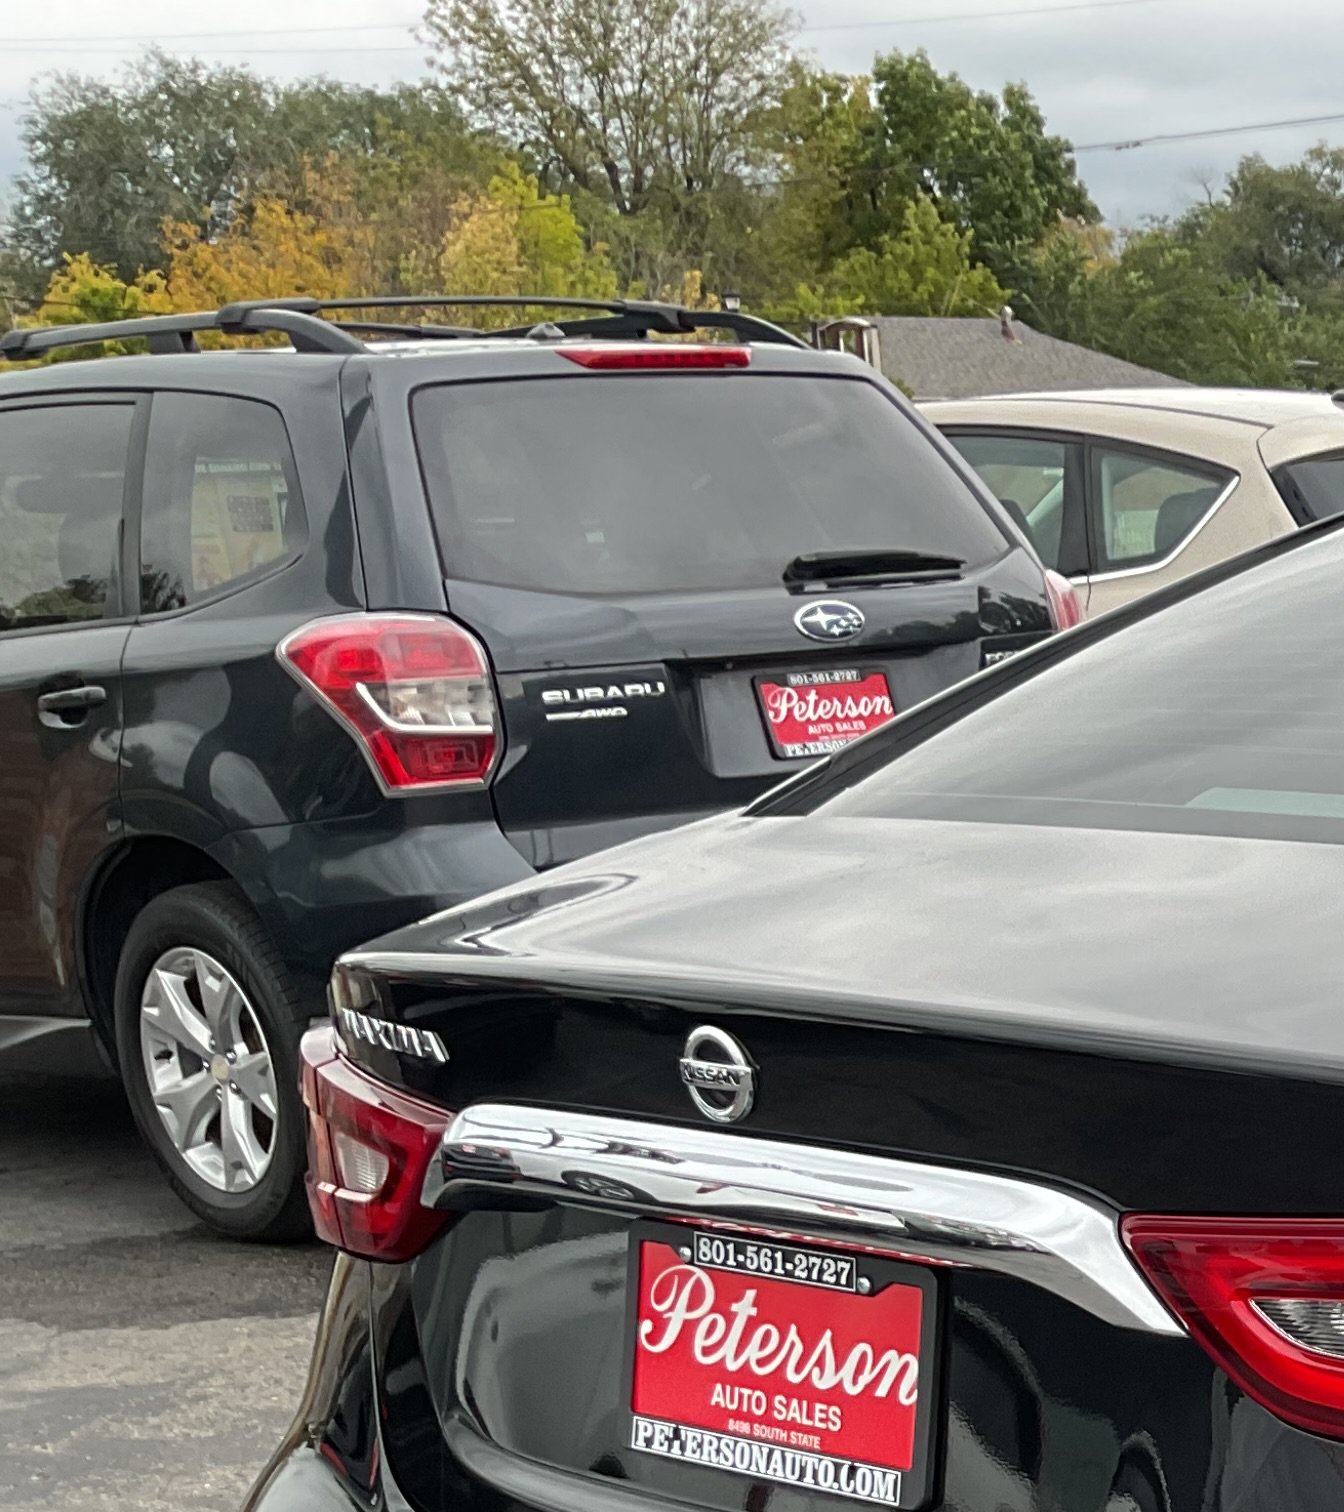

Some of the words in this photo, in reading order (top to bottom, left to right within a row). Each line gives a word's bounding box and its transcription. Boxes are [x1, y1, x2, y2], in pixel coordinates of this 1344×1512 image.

[542, 681, 665, 705] SUBARU
[790, 670, 858, 685] 801-561-2727
[579, 706, 628, 719] AWD
[768, 687, 894, 723] Peterson
[808, 722, 834, 735] AUTO
[835, 719, 867, 731] SALES
[342, 1007, 450, 1063] MAXIMA
[680, 1062, 741, 1087] NISSAN
[697, 1236, 851, 1287] 801-561-2727
[639, 1264, 920, 1406] Peterson
[710, 1383, 767, 1416] AUTO
[773, 1398, 842, 1432] SALES
[753, 1423, 788, 1442] SOUTH
[790, 1431, 821, 1449] STATE
[636, 1419, 897, 1502] PETERSONAUTO.COM
